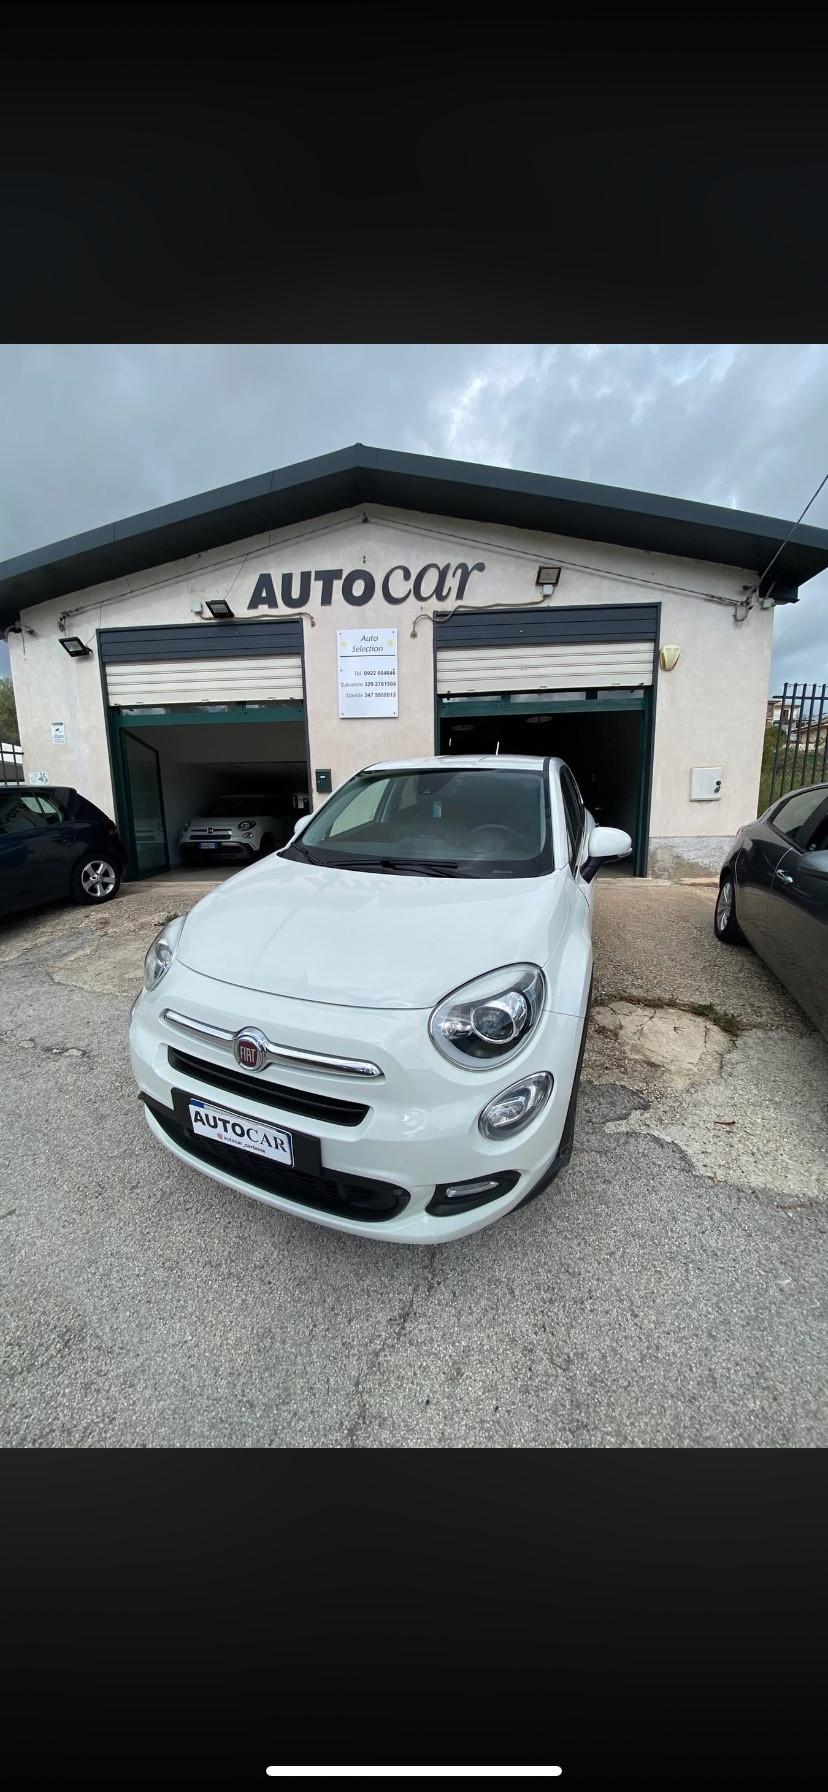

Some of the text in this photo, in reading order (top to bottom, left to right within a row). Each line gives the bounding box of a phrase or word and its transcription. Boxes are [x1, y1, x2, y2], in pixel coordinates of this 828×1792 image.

[360, 634, 379, 642] Auto
[351, 645, 384, 653] Selection
[240, 1045, 256, 1063] FIAT
[193, 1110, 288, 1153] AUTOCAR
